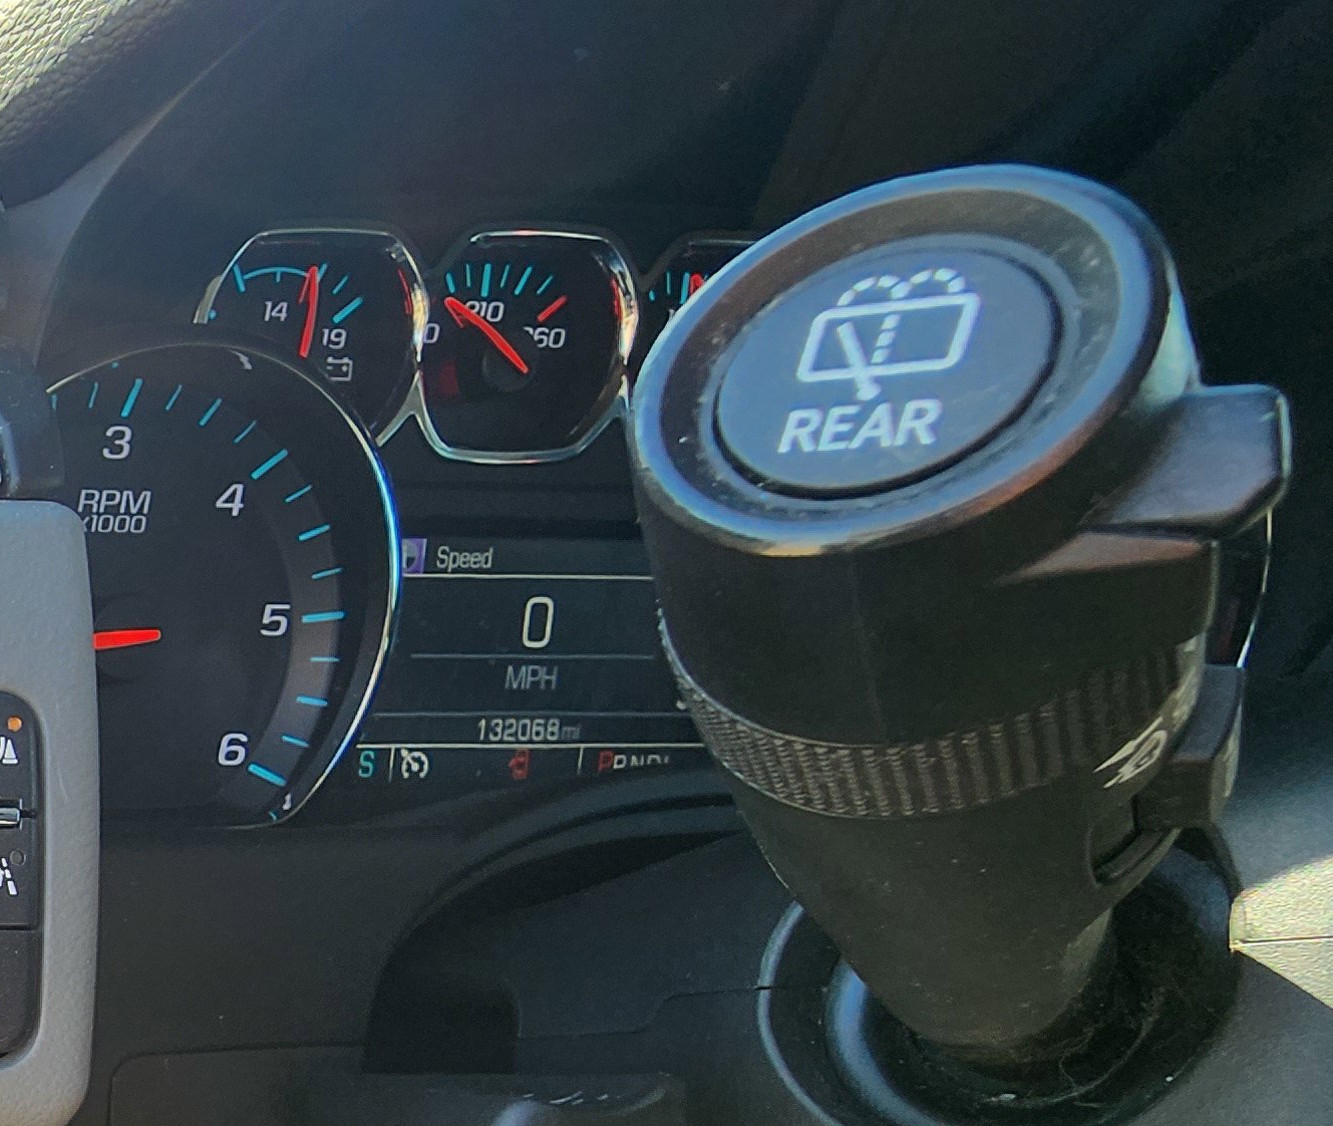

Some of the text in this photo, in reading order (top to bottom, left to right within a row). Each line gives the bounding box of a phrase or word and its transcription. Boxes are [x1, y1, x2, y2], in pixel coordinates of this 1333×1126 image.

[263, 301, 288, 321] 14
[322, 328, 347, 349] 19
[778, 400, 942, 454] REAR
[102, 425, 133, 460] 3
[77, 489, 152, 514] RPM
[215, 483, 245, 517] 4
[436, 546, 494, 573] Speed
[259, 603, 292, 637] 5
[522, 596, 555, 648] 0
[504, 664, 559, 690] MPH
[478, 718, 561, 741] 132068
[217, 732, 249, 767] 6
